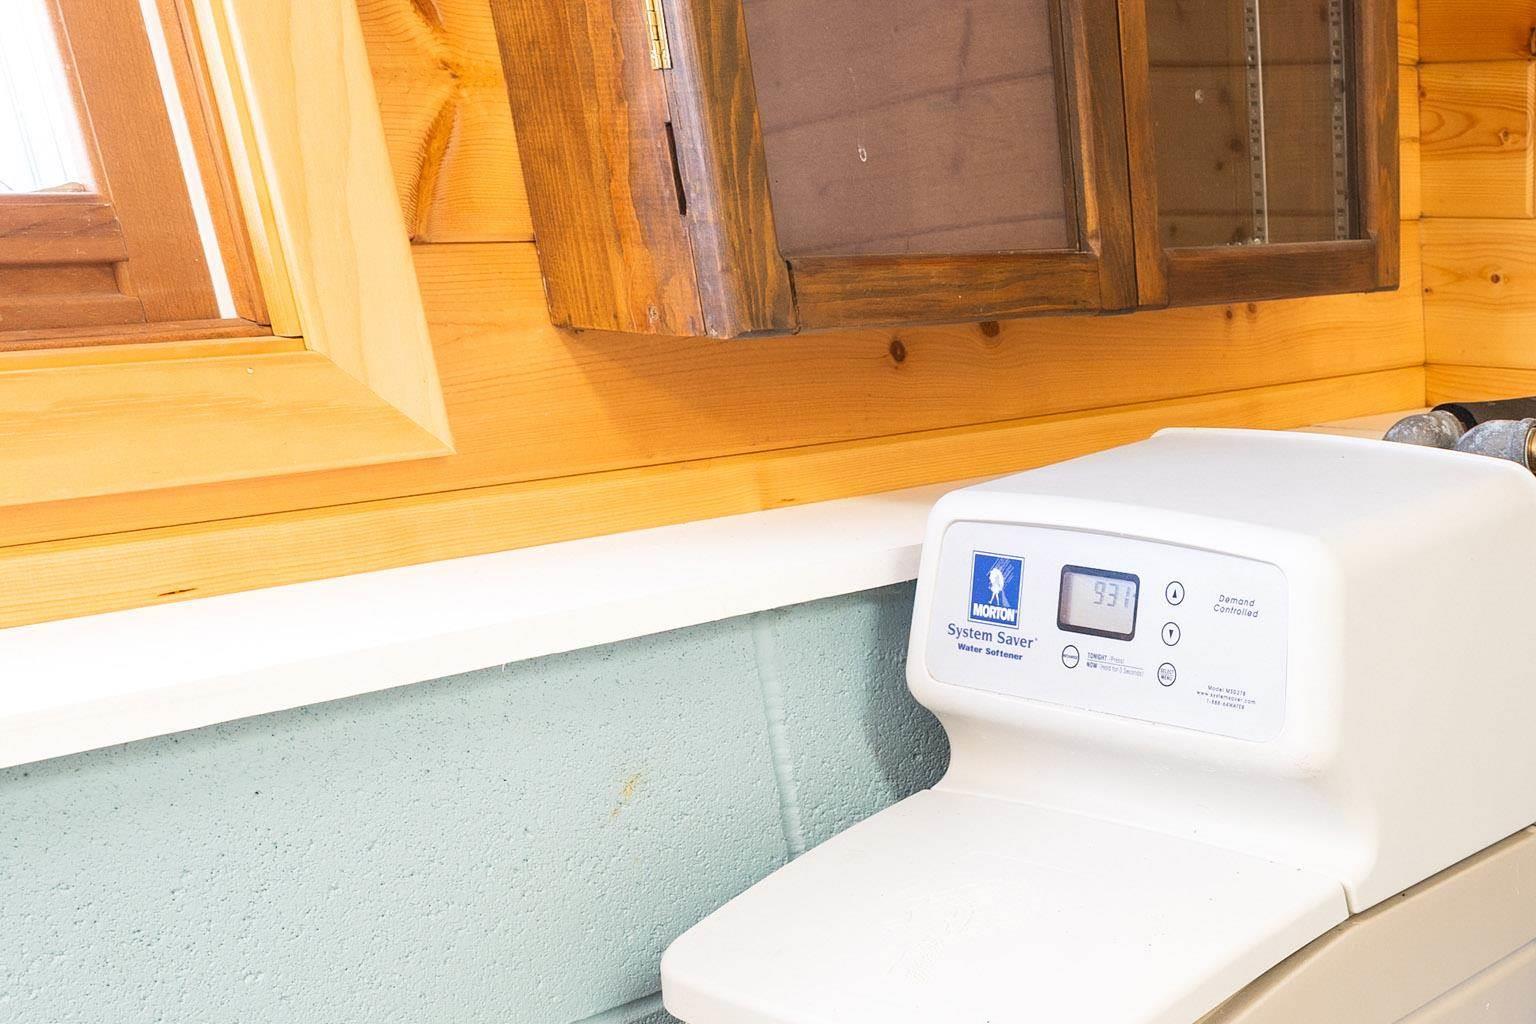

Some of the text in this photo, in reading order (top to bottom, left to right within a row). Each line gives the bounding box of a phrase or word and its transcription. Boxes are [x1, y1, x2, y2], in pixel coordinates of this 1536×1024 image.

[1218, 594, 1256, 607] Demand
[973, 602, 1015, 622] MORTON
[1213, 603, 1259, 618] Controlled
[947, 622, 1034, 648] System Saver
[957, 642, 1023, 661] Water Softener
